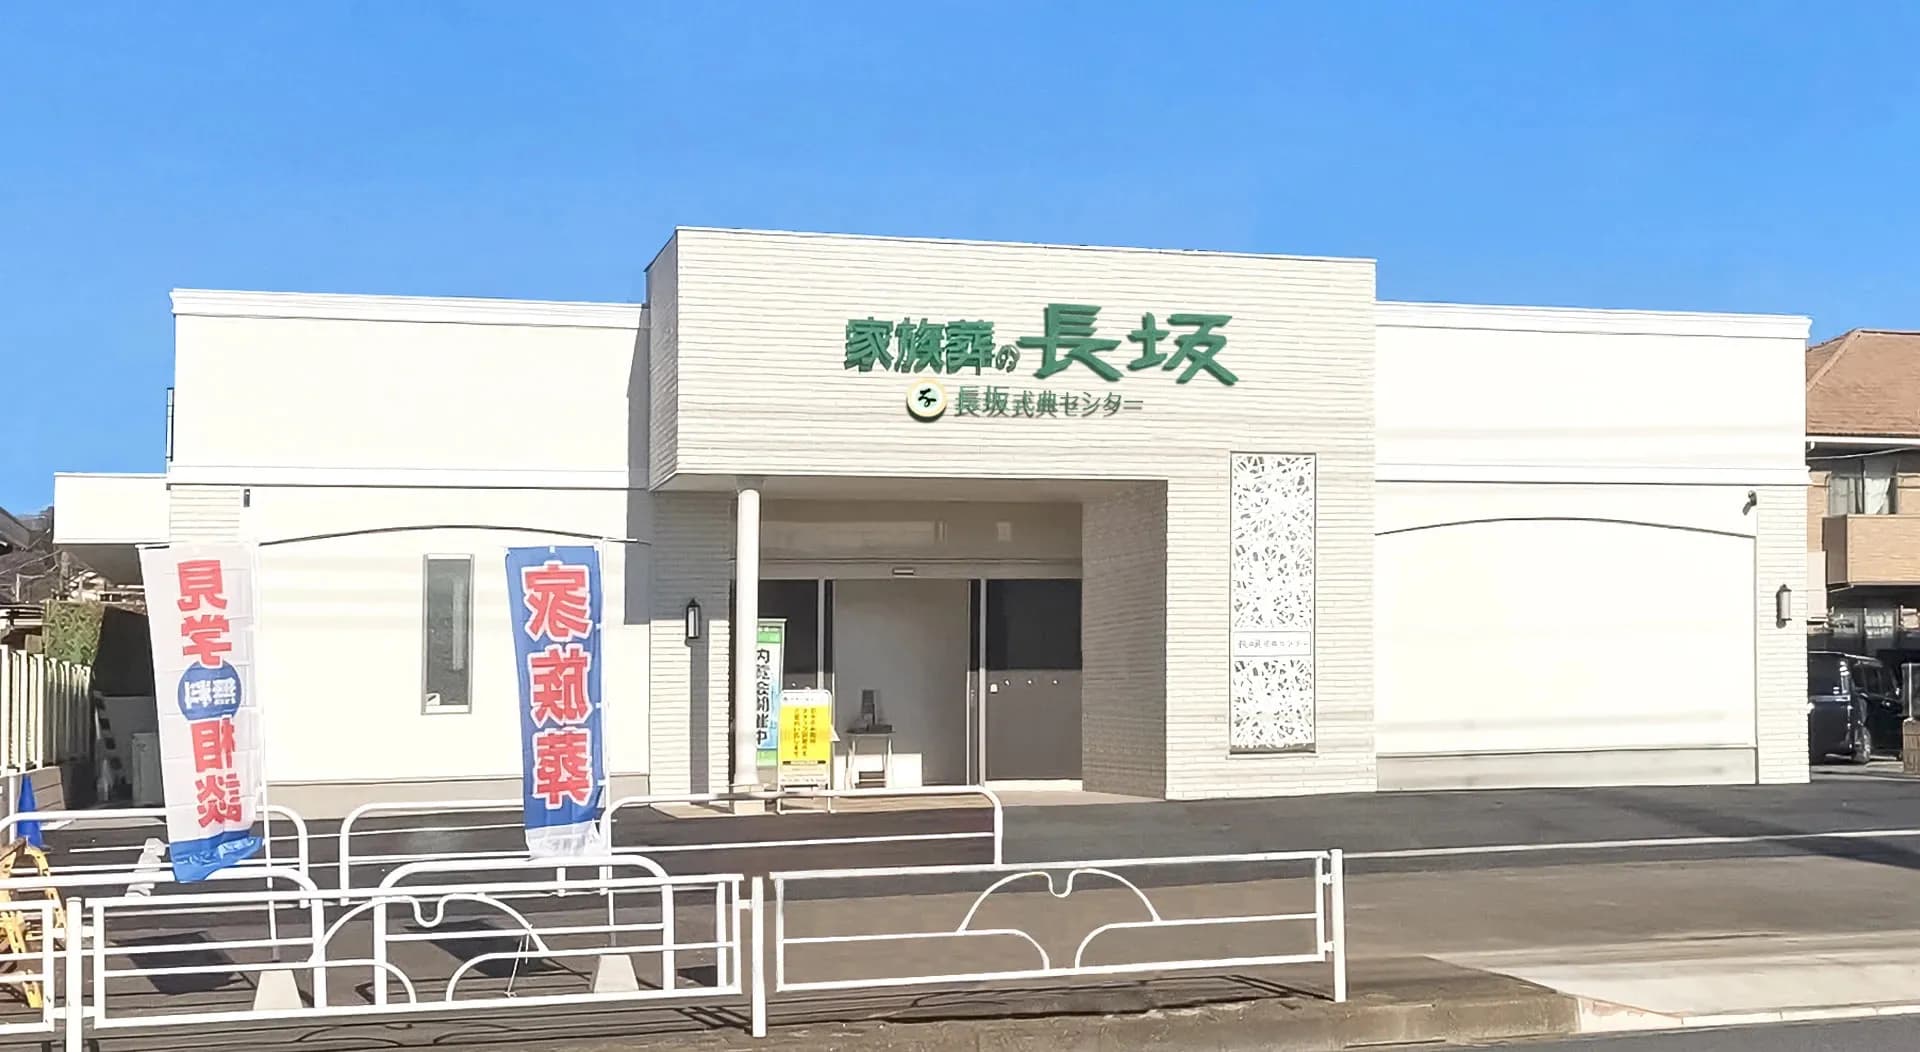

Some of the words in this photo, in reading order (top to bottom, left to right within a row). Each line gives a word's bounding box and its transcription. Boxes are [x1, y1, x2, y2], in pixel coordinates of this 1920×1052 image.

[845, 303, 1238, 385] 家族葬の長坂
[954, 385, 1143, 418] 長坂式典センター
